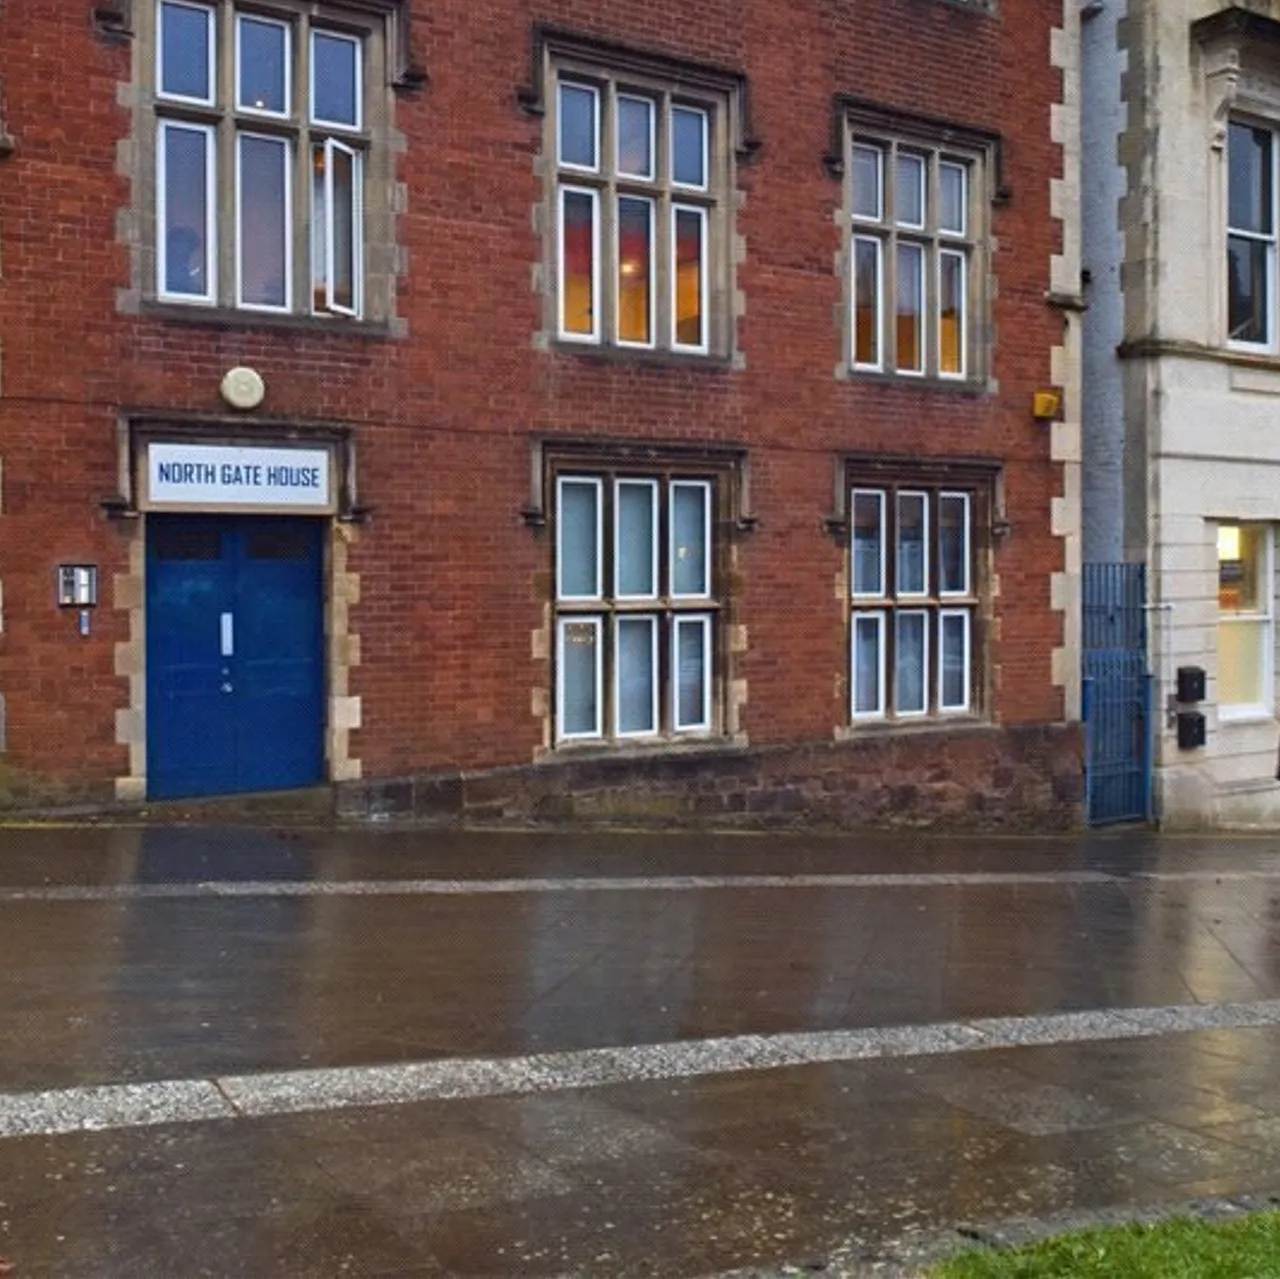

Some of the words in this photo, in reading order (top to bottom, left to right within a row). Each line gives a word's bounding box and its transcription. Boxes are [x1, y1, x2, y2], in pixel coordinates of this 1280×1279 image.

[158, 462, 216, 484] NORTH
[221, 464, 262, 486] GATE
[267, 467, 319, 488] HOUSE
